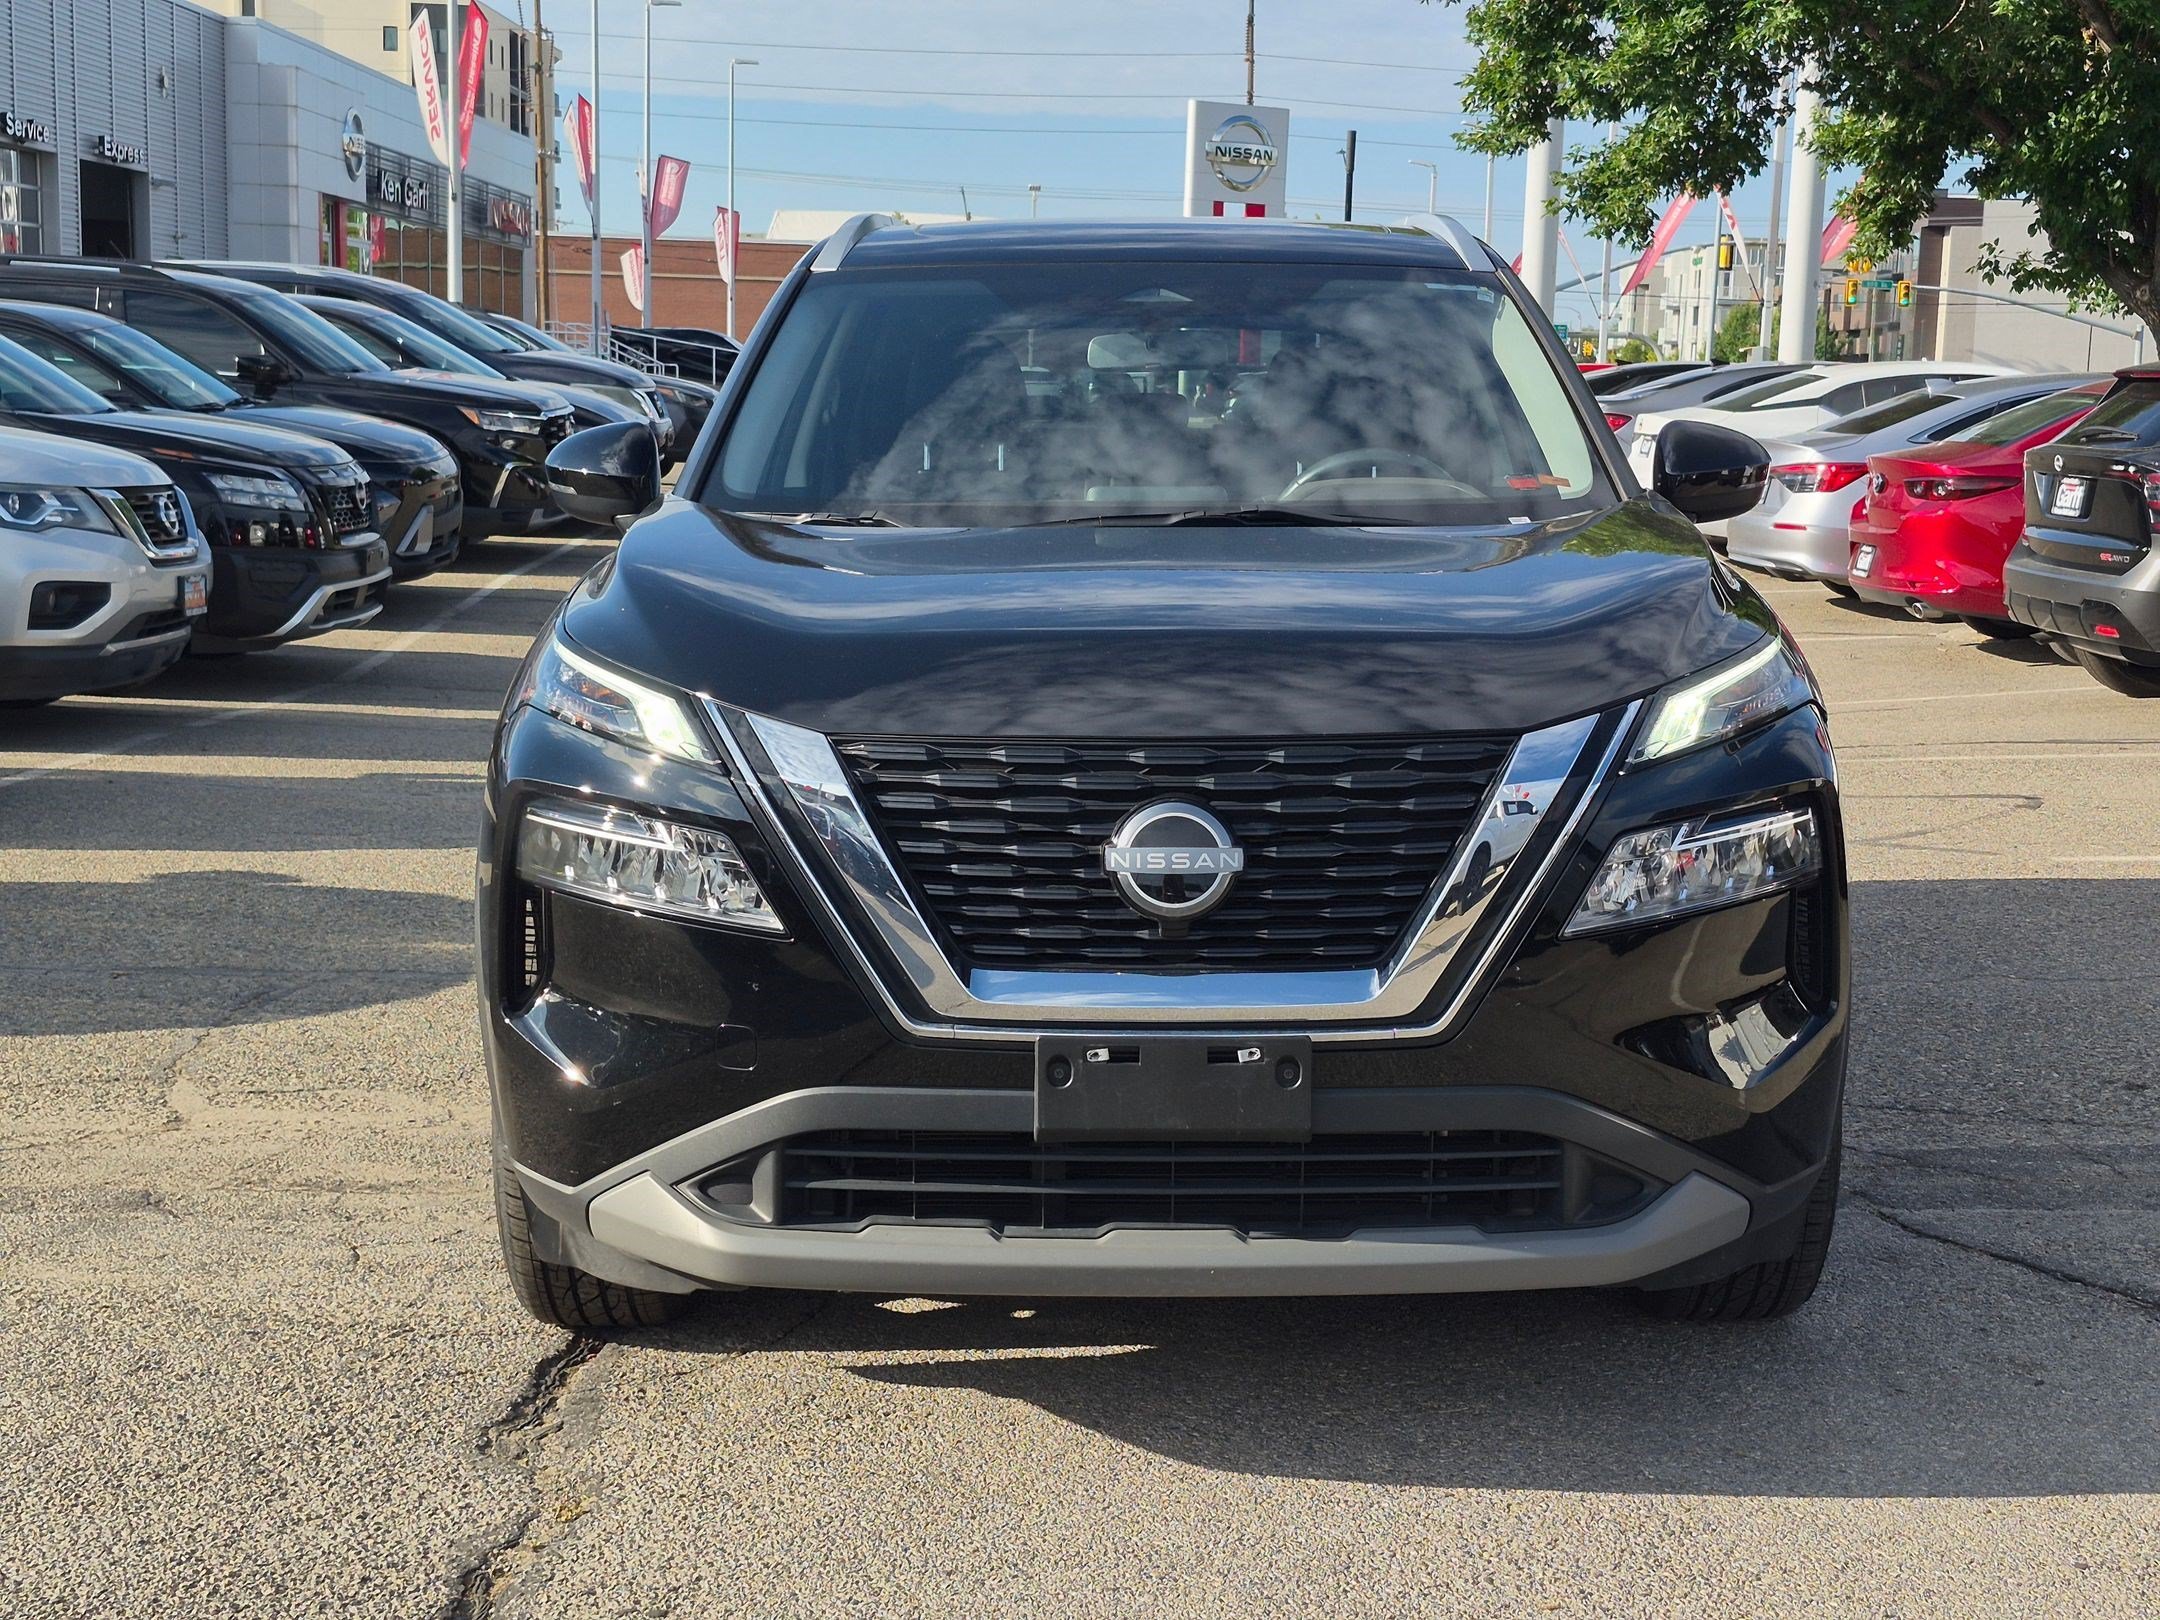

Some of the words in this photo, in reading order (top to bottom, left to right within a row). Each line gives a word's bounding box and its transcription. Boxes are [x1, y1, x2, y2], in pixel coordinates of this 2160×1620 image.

[6, 111, 50, 142] Service
[104, 134, 146, 164] Express
[1215, 145, 1273, 161] NISSAN
[381, 170, 401, 204] Ken
[404, 177, 429, 210] Garff
[1110, 852, 1239, 869] NISSAN
